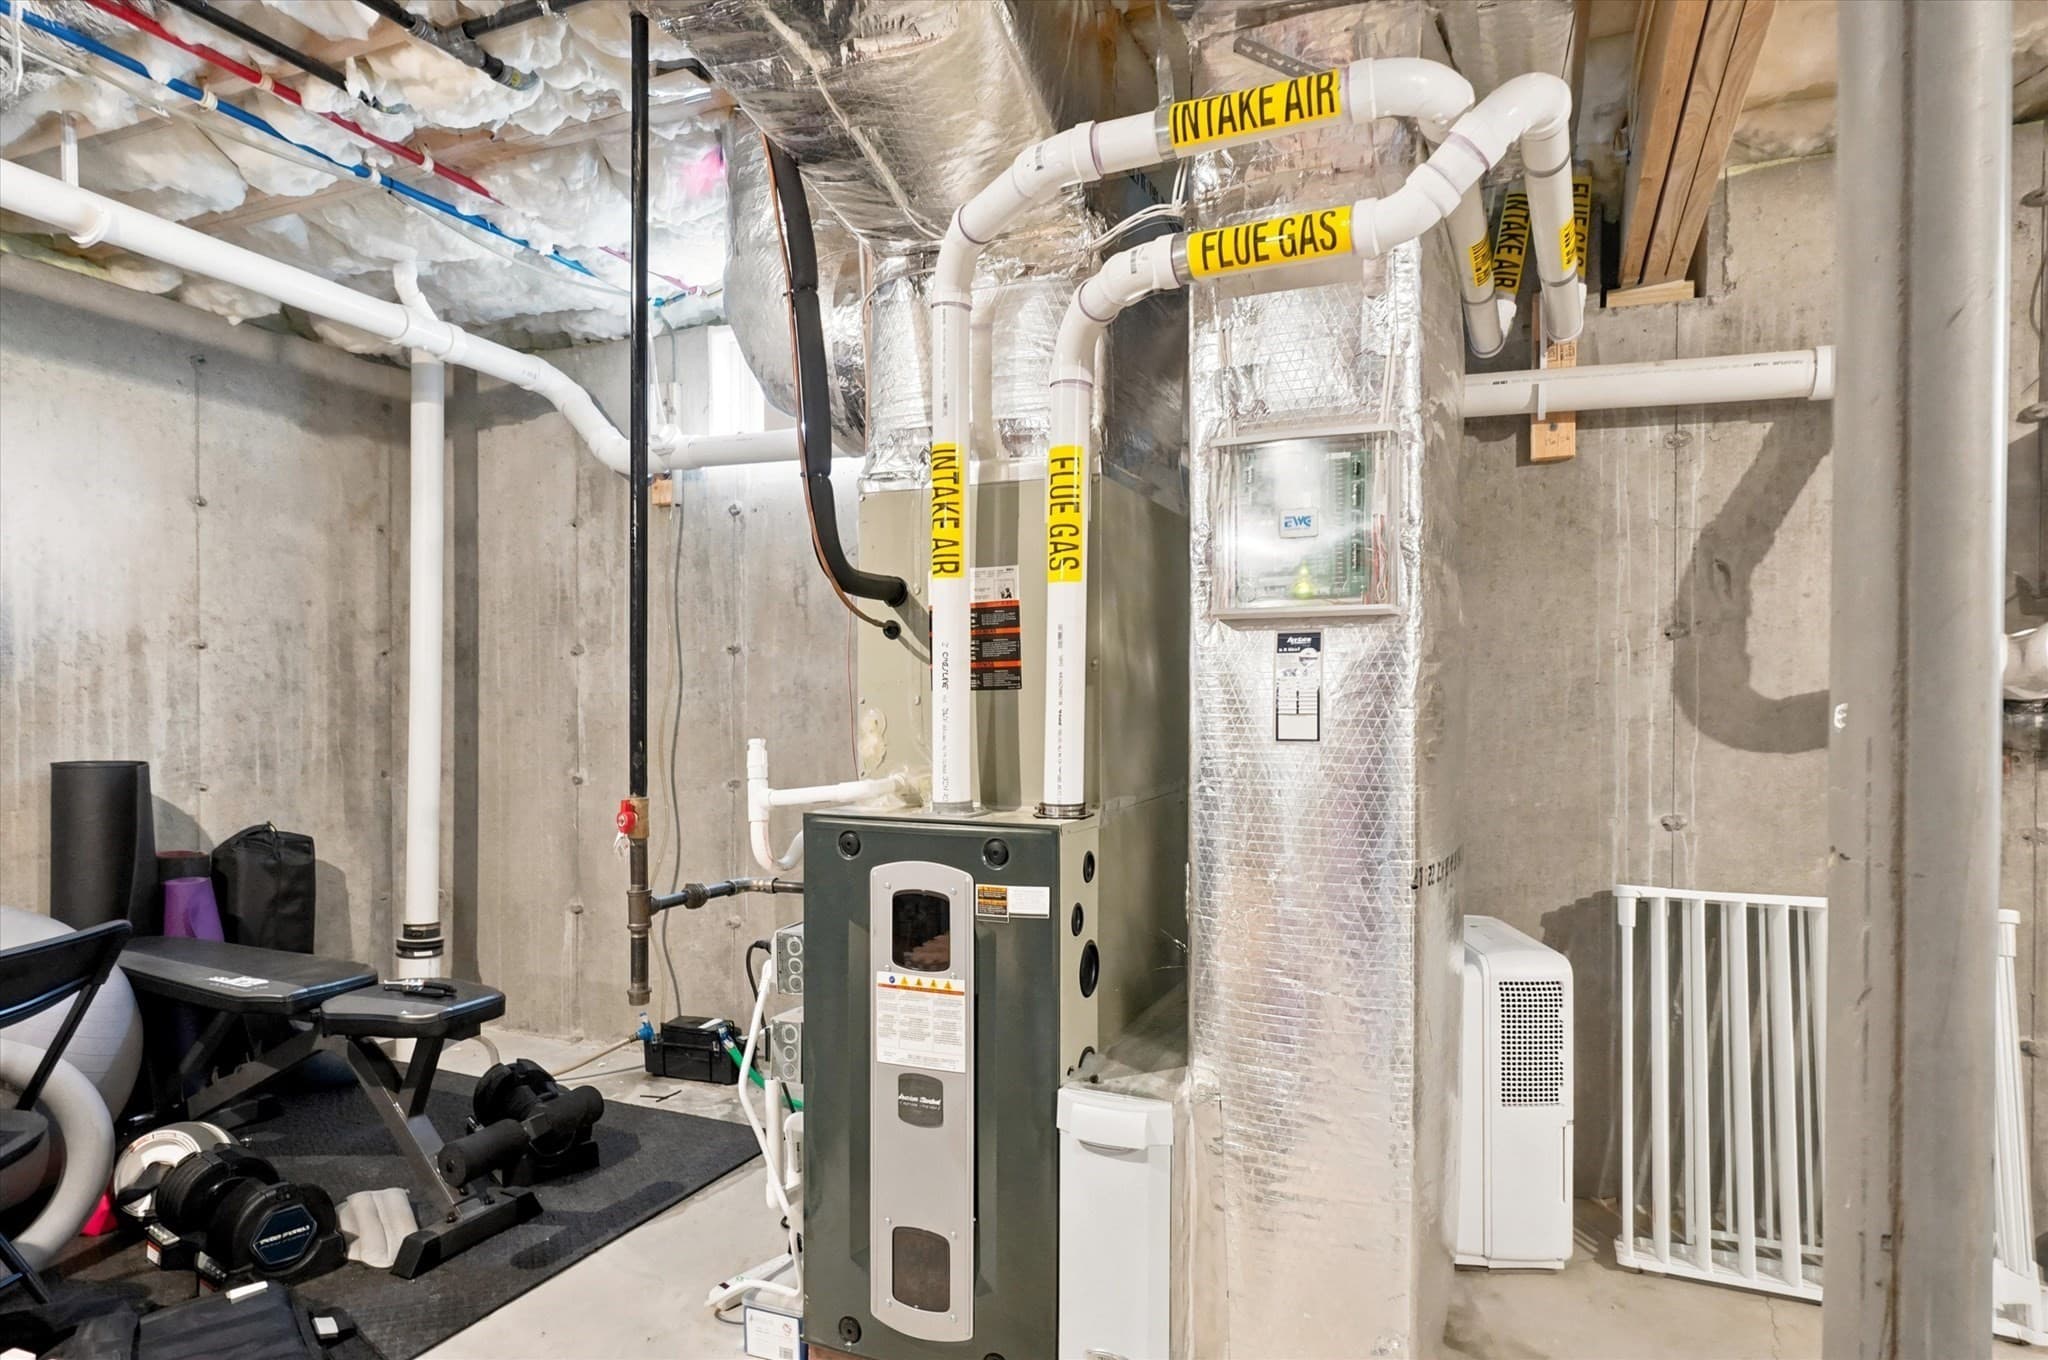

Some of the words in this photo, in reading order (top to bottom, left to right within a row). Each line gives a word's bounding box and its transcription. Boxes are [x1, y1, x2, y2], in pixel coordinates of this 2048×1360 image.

[1172, 83, 1276, 144] INTAKE
[1284, 71, 1335, 122] AIR
[1201, 221, 1270, 271] FLUE
[1279, 210, 1338, 258] GAS
[1496, 193, 1530, 257] INTAKE
[1493, 258, 1521, 289] AIR
[931, 448, 960, 529] INTAKE
[1049, 456, 1080, 516] FLUE
[931, 537, 960, 576] AIR
[1048, 523, 1080, 571] GAS
